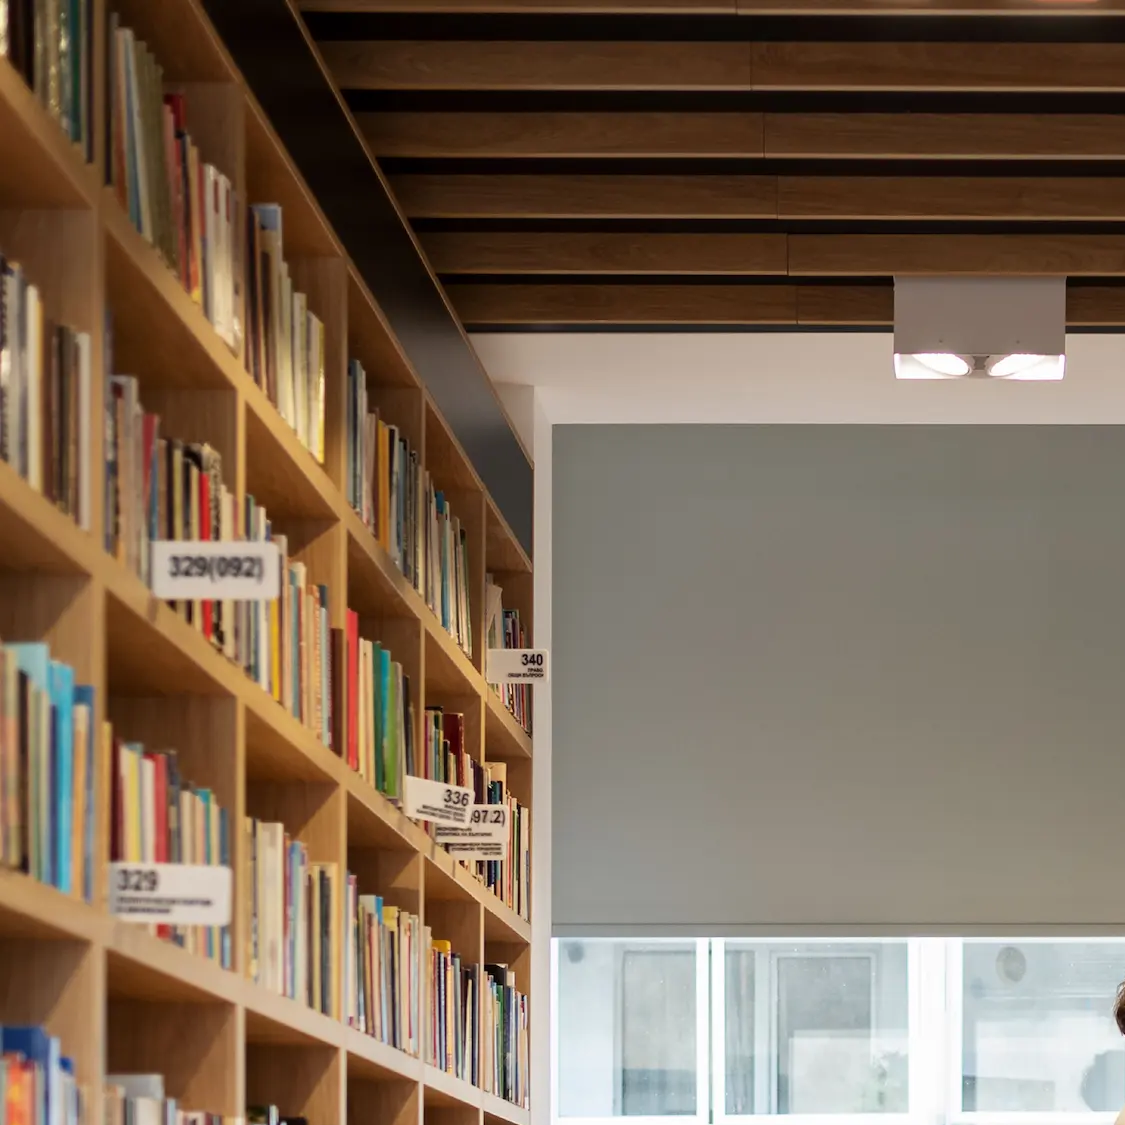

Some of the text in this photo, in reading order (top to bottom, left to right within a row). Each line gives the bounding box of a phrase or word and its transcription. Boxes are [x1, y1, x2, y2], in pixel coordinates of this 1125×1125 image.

[169, 555, 263, 583] 329(092)
[521, 653, 543, 666] 340
[443, 789, 469, 806] 336
[118, 869, 158, 891] 329
